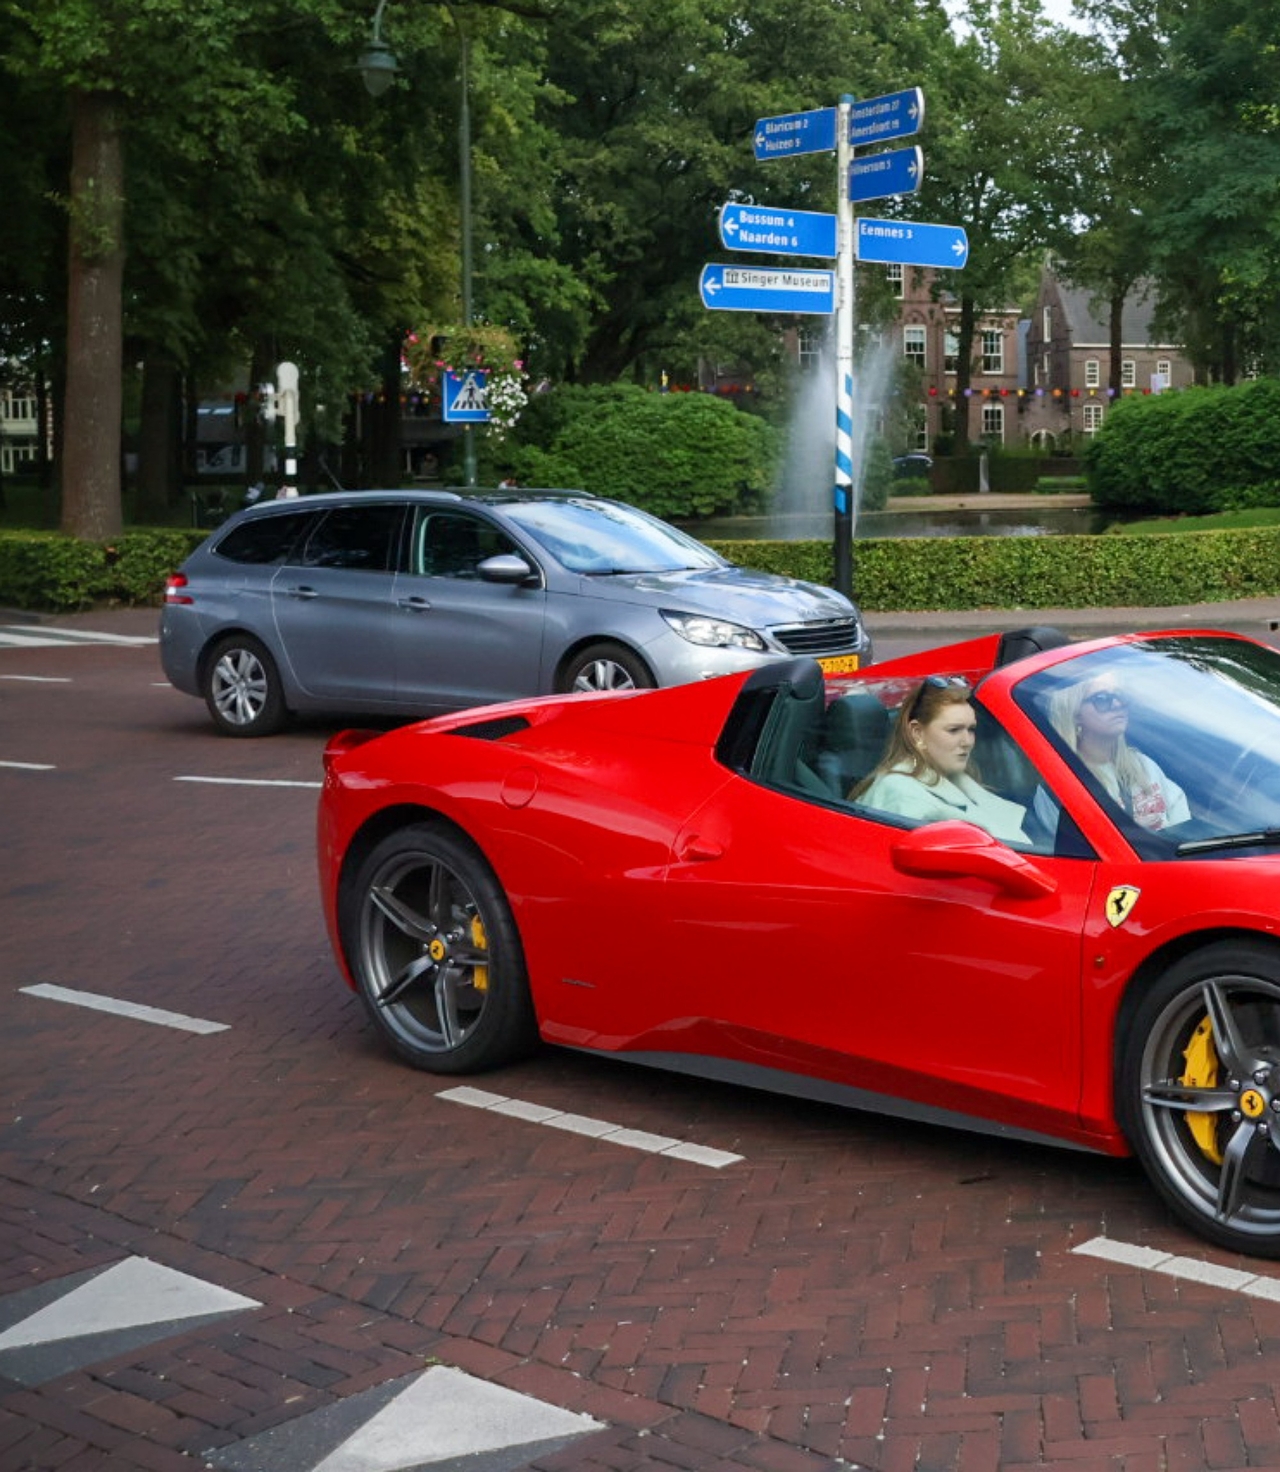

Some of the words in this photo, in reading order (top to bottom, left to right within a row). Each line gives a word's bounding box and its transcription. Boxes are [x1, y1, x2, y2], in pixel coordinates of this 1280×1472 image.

[765, 120, 802, 134] Blaricum
[803, 118, 809, 129] 2
[765, 138, 794, 152] Huizen
[739, 210, 784, 227] Bussum
[786, 217, 795, 228] 4
[739, 230, 788, 247] Naarden
[791, 236, 799, 247] 6
[860, 223, 904, 239] Eemnes
[906, 229, 914, 239] 3
[741, 272, 778, 288] Singer
[782, 273, 829, 288] Museum
